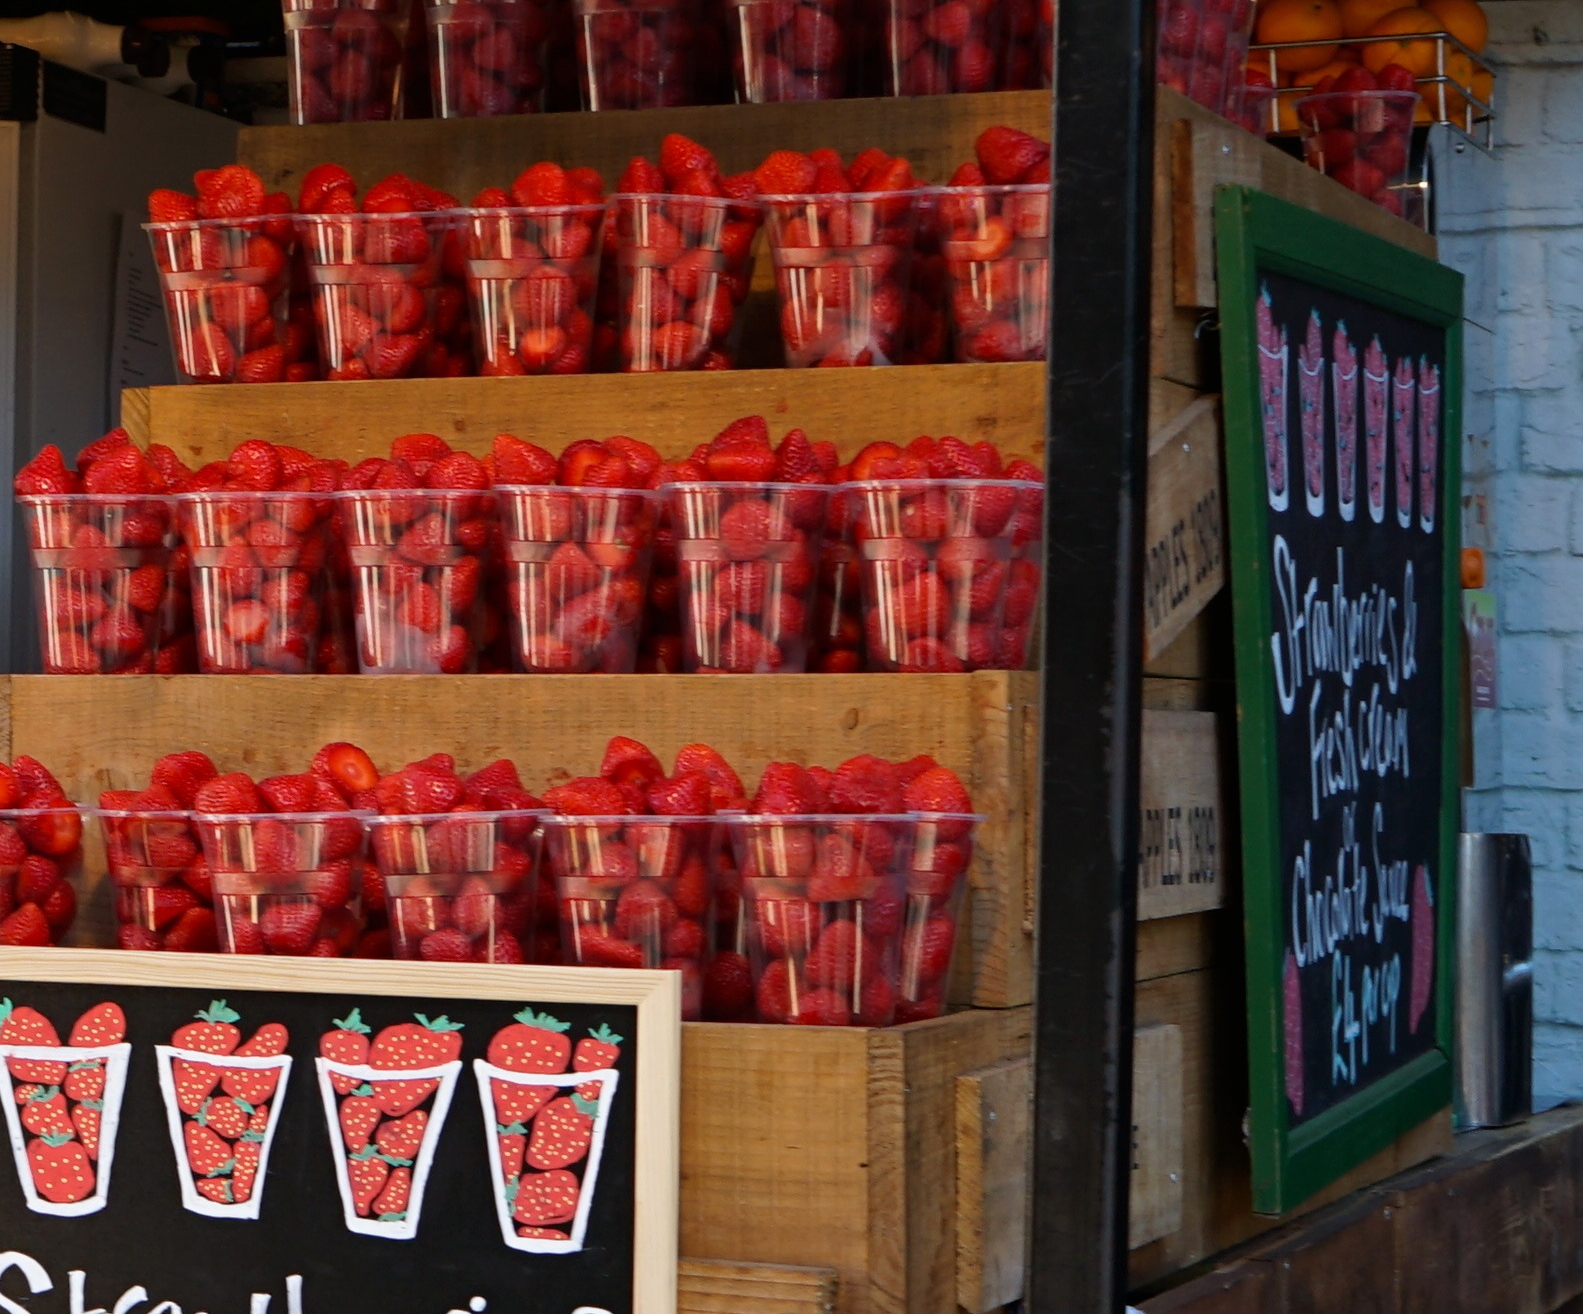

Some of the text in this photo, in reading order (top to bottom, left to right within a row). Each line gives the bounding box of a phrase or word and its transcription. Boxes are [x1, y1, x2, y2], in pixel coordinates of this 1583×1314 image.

[1271, 534, 1399, 715] Strawberries
[1310, 678, 1359, 821] Fresh
[1292, 839, 1370, 968] Chocolate
